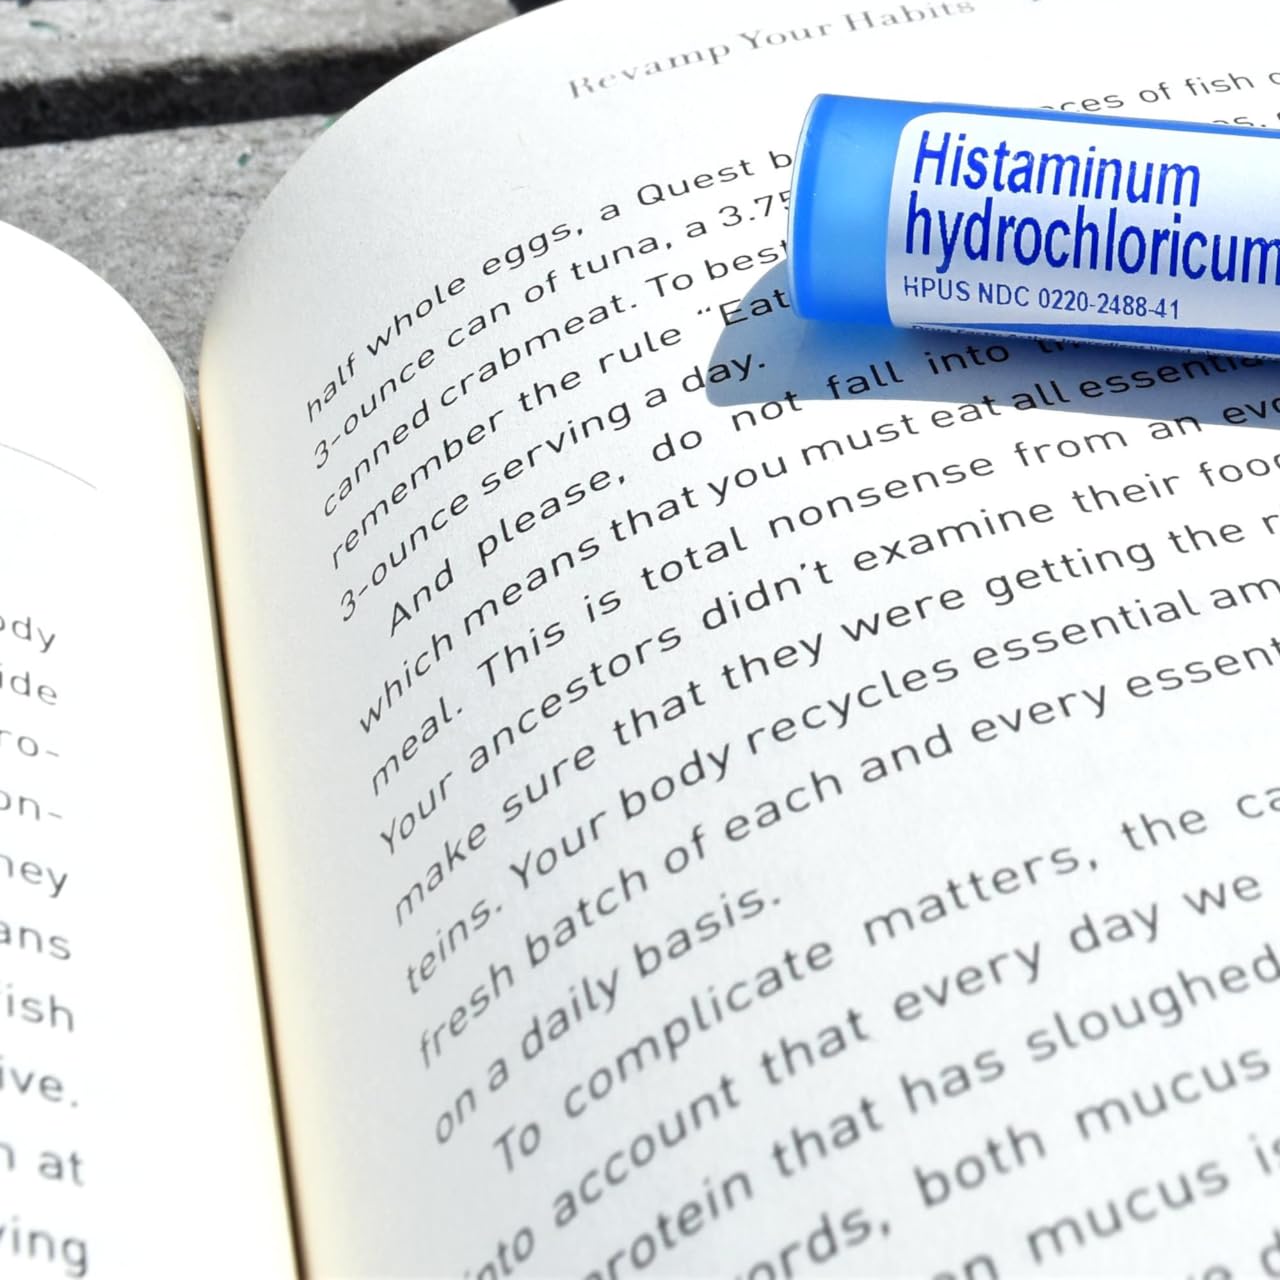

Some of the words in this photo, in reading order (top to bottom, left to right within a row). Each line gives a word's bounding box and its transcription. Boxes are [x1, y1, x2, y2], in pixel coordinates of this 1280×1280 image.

[570, 46, 730, 98] Revamp
[738, 24, 832, 50] Your
[845, 2, 975, 31] Habits
[913, 130, 1201, 207] Histaminum
[1139, 82, 1170, 102] of
[1186, 73, 1254, 96] fish
[307, 352, 355, 423] half
[367, 278, 465, 356] whole
[483, 224, 582, 275] eggs,
[637, 160, 754, 205] Quest
[315, 349, 435, 469] 3-ounce
[448, 302, 510, 347] can
[570, 237, 672, 280] tuna,
[325, 399, 429, 516] canned
[441, 295, 636, 406] crabmeat.
[645, 273, 693, 297] To
[904, 276, 971, 302] HPUS
[978, 283, 1030, 308] NDC
[1038, 289, 1181, 320] 0220-2488-41
[333, 410, 503, 569] remember
[518, 372, 581, 412] the
[599, 329, 681, 374] rule
[341, 494, 468, 621] 3-ounce
[482, 402, 631, 495] serving
[682, 354, 765, 392] day.
[360, 634, 452, 733] which
[464, 537, 599, 636] means
[610, 487, 699, 541] that
[707, 457, 787, 507] you
[801, 415, 919, 466] must
[931, 396, 1001, 428] eat
[1012, 381, 1070, 410] all
[391, 558, 453, 637] And
[478, 471, 624, 567] please,
[732, 392, 802, 431] not
[827, 361, 904, 400] fall
[928, 342, 1010, 376] into
[373, 696, 462, 796] meal.
[477, 622, 565, 687] This
[641, 527, 747, 590] total
[769, 459, 994, 538] nonsense
[1014, 432, 1127, 466] from
[1148, 416, 1202, 439] an
[380, 772, 452, 854] Your
[470, 627, 681, 773] ancestors
[854, 504, 1054, 571] examine
[1072, 474, 1179, 512] their
[396, 823, 486, 926] make
[503, 745, 595, 823] sure
[613, 681, 705, 745] that
[722, 633, 822, 690] they
[841, 589, 965, 641] were
[986, 543, 1155, 606] getting
[1168, 524, 1245, 553] the
[407, 900, 502, 994] teins.
[509, 811, 606, 889] Your
[620, 744, 729, 820] body
[747, 659, 958, 755] recycles
[973, 590, 1200, 669] essential
[420, 964, 514, 1069] fresh
[526, 869, 647, 968] batch
[725, 771, 842, 841] each
[861, 724, 952, 782] and
[971, 685, 1105, 742] every
[493, 1122, 541, 1172] To
[564, 942, 832, 1119] complicate
[864, 848, 1097, 946] matters,
[1122, 810, 1207, 850] the
[522, 968, 618, 1061] daily
[633, 889, 780, 978] basis.
[554, 1076, 739, 1228] account
[761, 1009, 869, 1085] that
[894, 942, 1040, 1021] every
[1070, 903, 1157, 953] day
[39, 1152, 82, 1186] at
[773, 1098, 882, 1178] that
[900, 1050, 1005, 1114] has
[914, 1126, 1046, 1208] both
[1075, 1050, 1270, 1140] mucus
[1027, 1161, 1229, 1264] mucus
